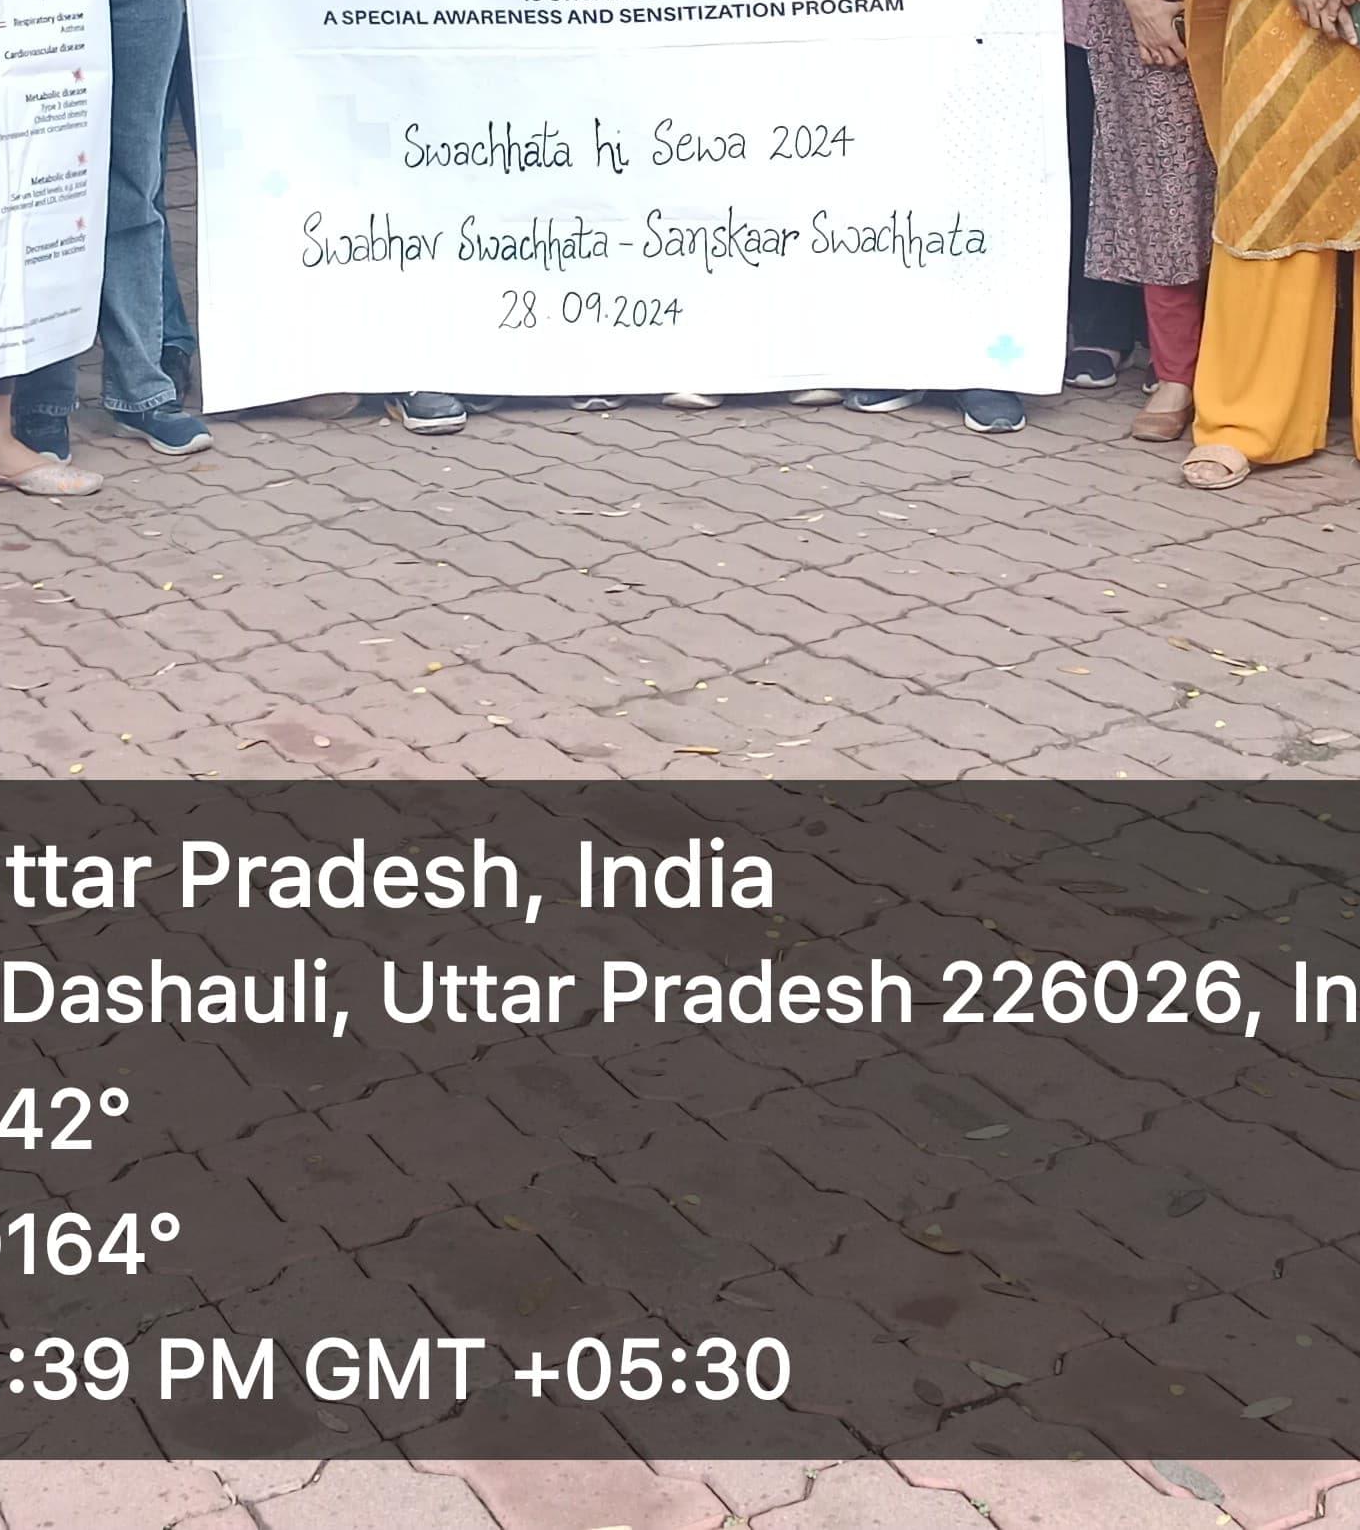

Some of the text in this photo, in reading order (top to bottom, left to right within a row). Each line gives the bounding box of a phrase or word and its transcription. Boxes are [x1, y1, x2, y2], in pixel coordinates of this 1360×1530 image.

[323, 10, 338, 26] A
[340, 7, 429, 26] SPECIAL
[432, 6, 563, 26] AWARENESS
[567, 6, 614, 25] AND
[619, 1, 786, 25] SENSITIZATION
[404, 118, 856, 174] Swachhata hi Sewa 2024
[301, 210, 443, 272] Swabhav
[457, 214, 610, 272] Swachhata
[642, 206, 799, 274] Sanskaar
[811, 209, 989, 271] Swachhata
